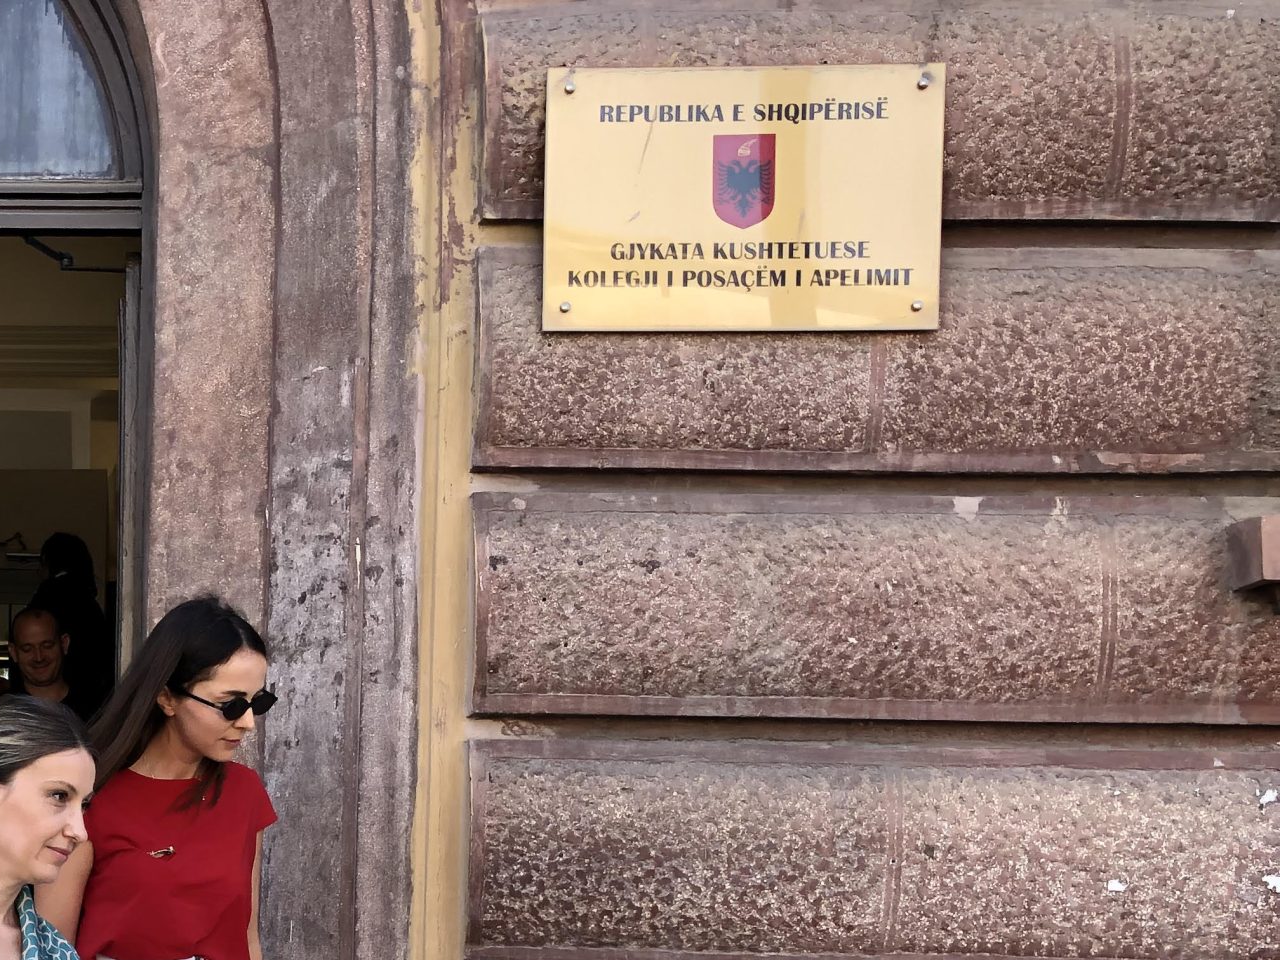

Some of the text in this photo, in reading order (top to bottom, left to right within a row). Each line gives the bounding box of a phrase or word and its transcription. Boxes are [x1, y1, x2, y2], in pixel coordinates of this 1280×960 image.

[599, 96, 889, 124] REPUBLIKA E SHQIPËRISË
[610, 240, 870, 260] GJYKATA KUSHTETUESE
[567, 265, 915, 292] KOLEGJI I POSAÇËM I APELIMIT
